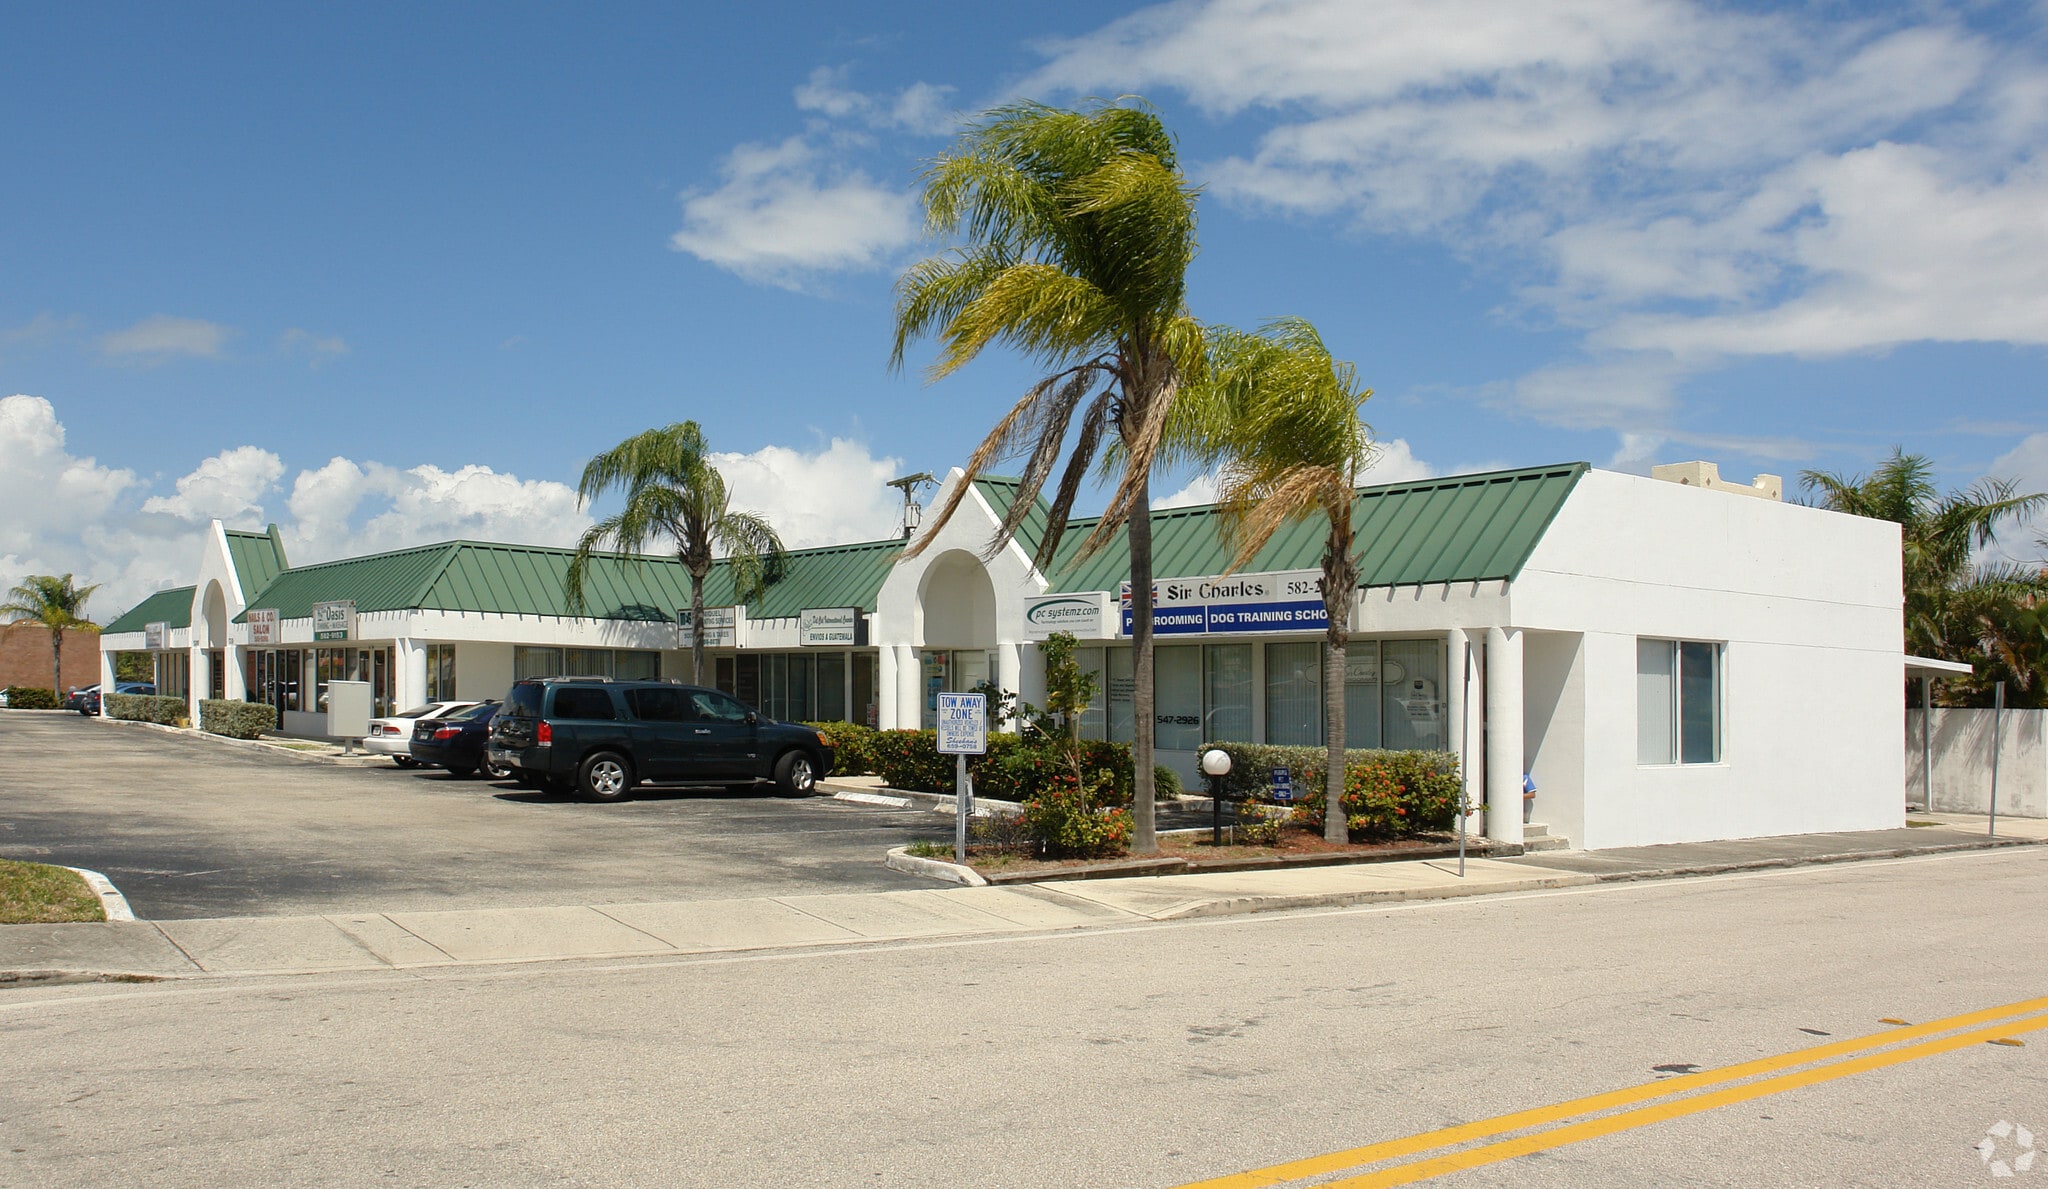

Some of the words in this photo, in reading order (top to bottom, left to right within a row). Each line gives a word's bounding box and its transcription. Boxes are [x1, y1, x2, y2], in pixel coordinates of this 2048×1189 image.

[1167, 584, 1192, 600] Sir
[1199, 581, 1264, 599] Charles
[1287, 581, 1321, 594] 582-2
[326, 606, 345, 620] Oasis
[1047, 606, 1099, 619] systemz.com
[1152, 614, 1203, 626] ROOMING
[1210, 613, 1235, 624] DOG
[1237, 611, 1292, 623] TRAINING
[1295, 609, 1328, 620] SCHO
[253, 624, 269, 634] SALON
[941, 697, 957, 708] TOW
[960, 697, 982, 708] AWAY
[951, 709, 973, 719] ZONE
[1157, 715, 1199, 724] 547-2926
